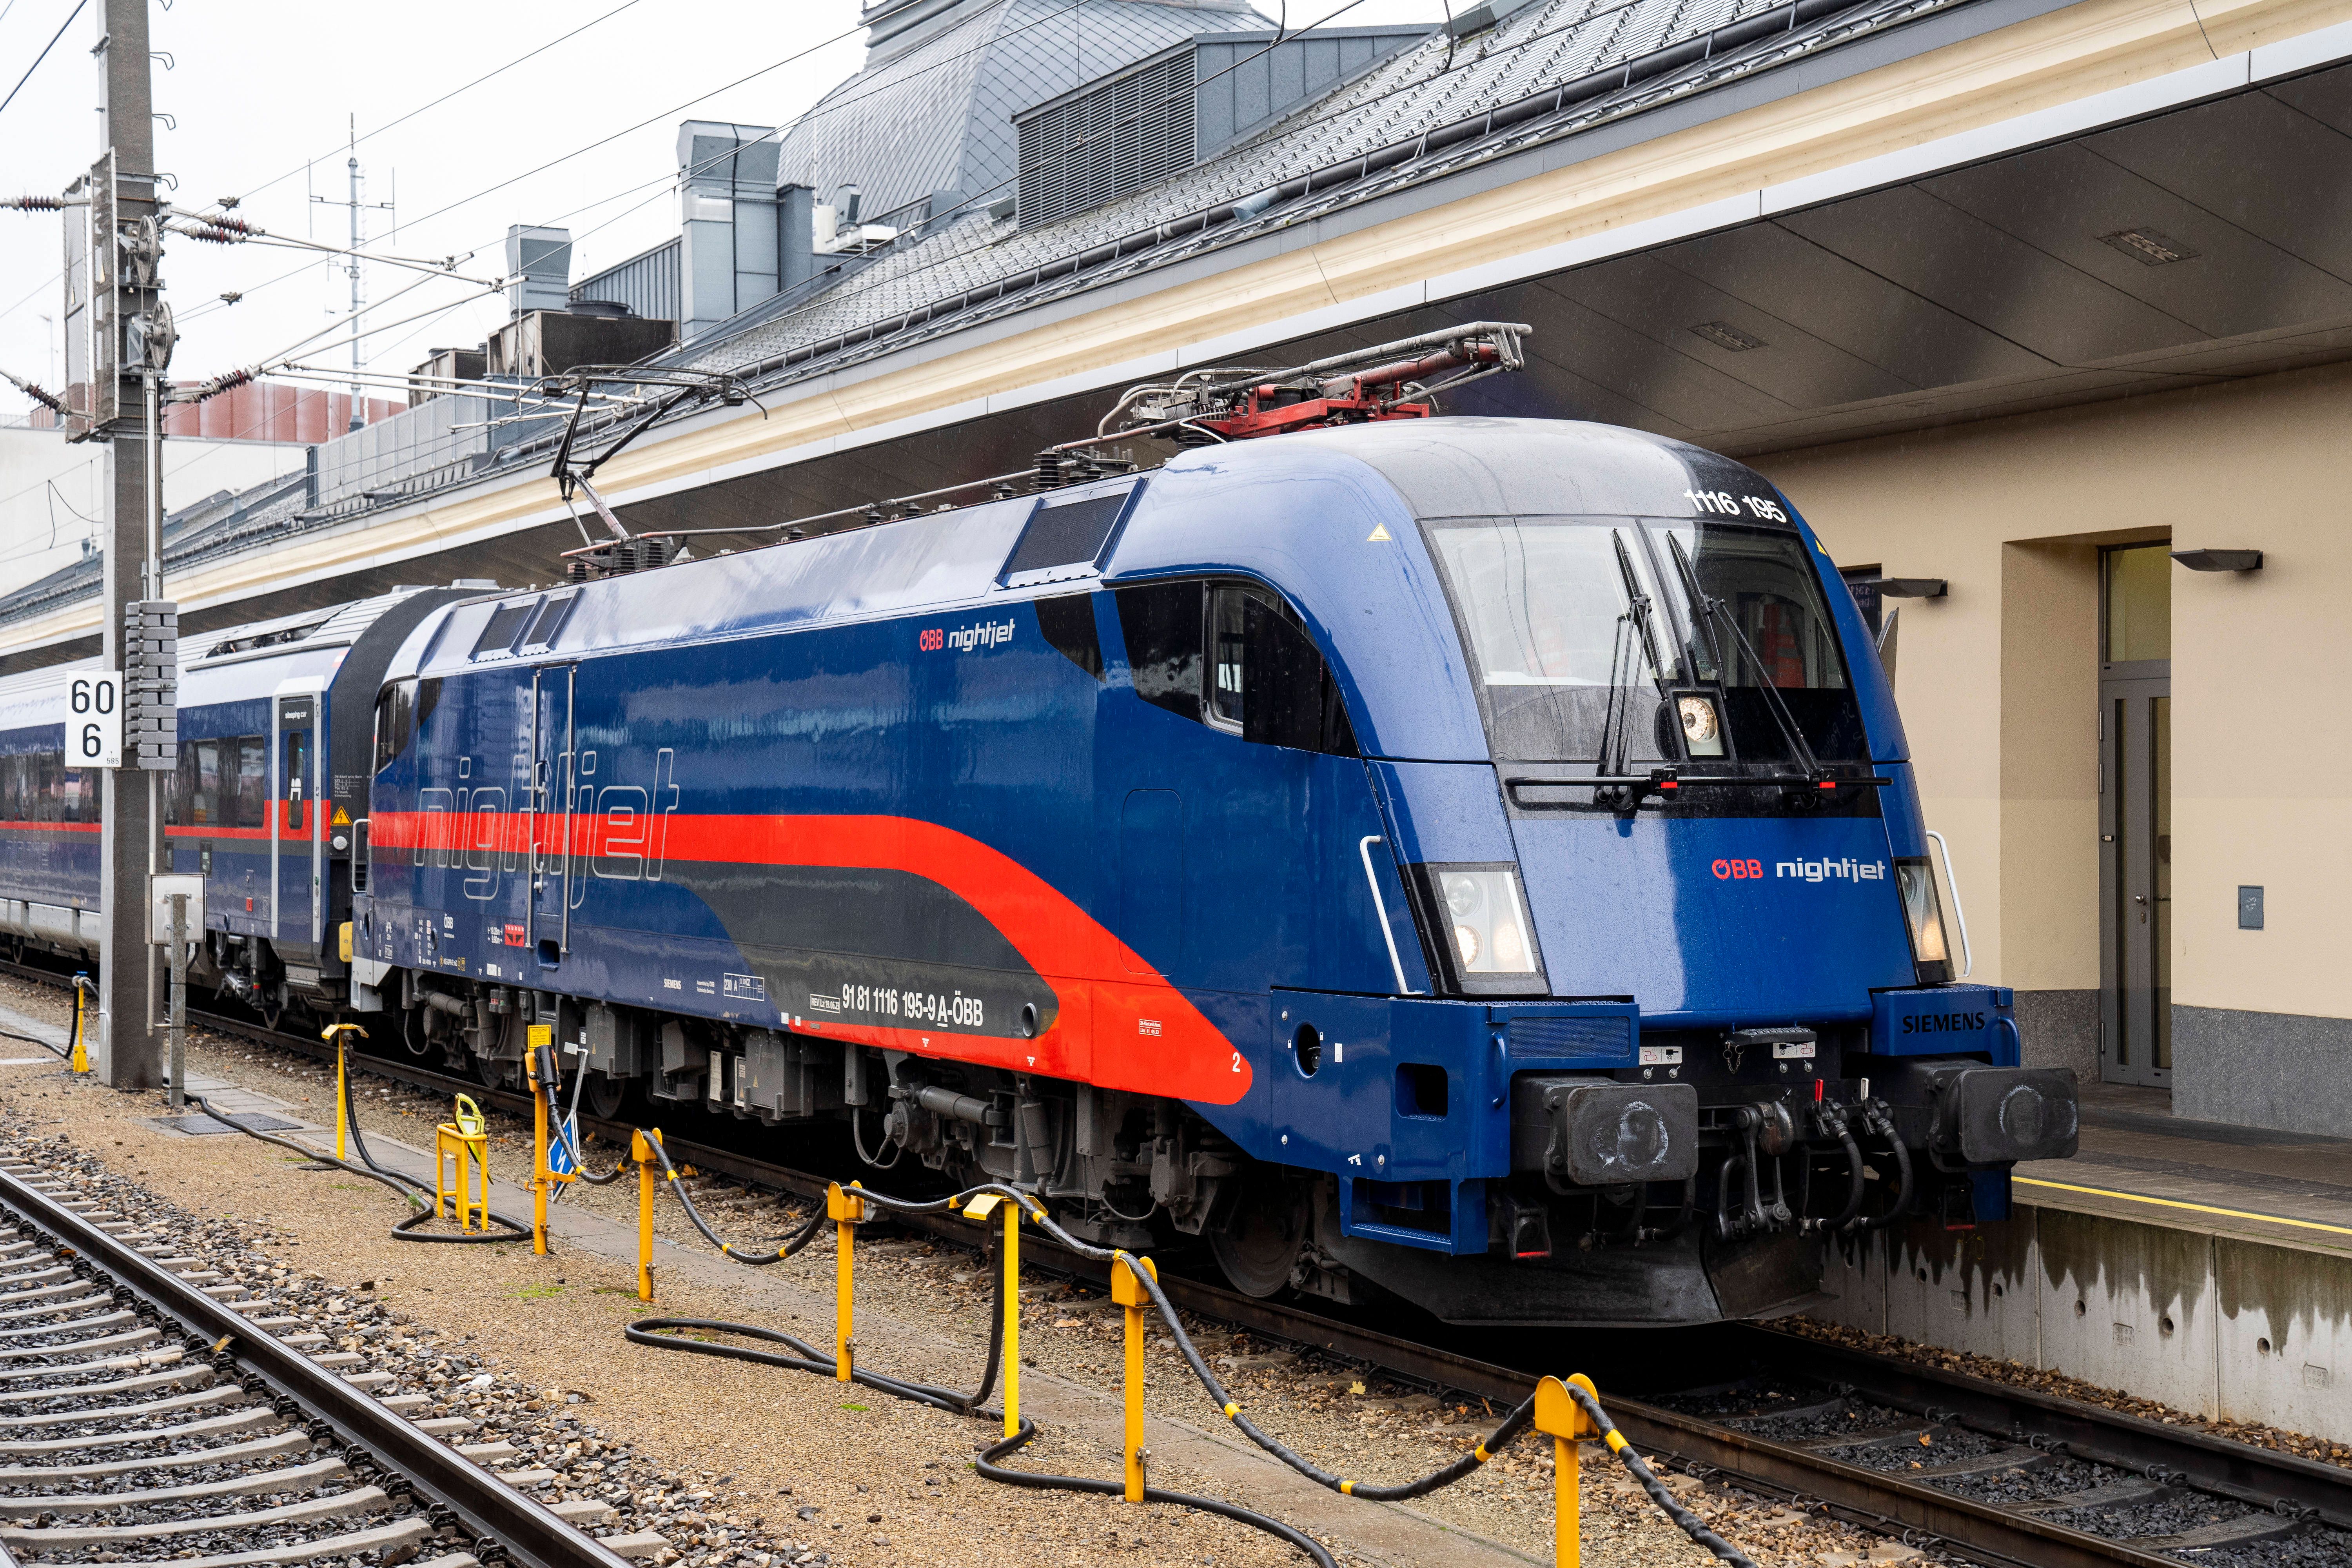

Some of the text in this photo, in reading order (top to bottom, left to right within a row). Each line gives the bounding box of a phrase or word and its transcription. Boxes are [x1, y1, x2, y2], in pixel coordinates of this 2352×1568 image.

[1683, 488, 1787, 523] 1116 195
[920, 618, 1015, 652] ÖBB nightjet
[72, 680, 114, 714] 60
[83, 723, 101, 757] 6
[414, 748, 679, 909] nightjet
[1712, 857, 1885, 882] ÖBB nightjet
[444, 913, 453, 929] ÖBB
[664, 978, 681, 990] SIEMENS
[734, 980, 738, 992] A
[843, 984, 983, 1027] 91 81 1116 195-9 A-ÖBB
[1902, 1012, 1985, 1034] SIEMENS
[1232, 1052, 1240, 1072] 2
